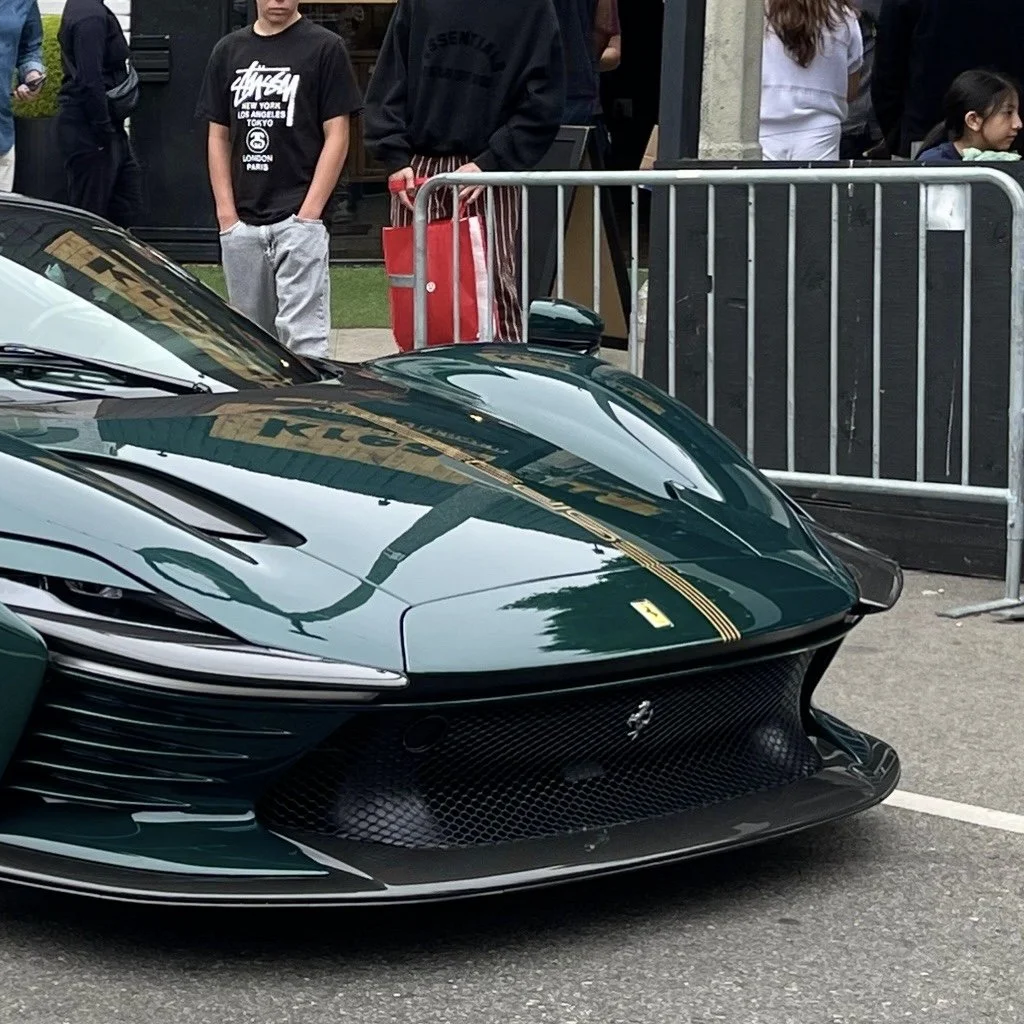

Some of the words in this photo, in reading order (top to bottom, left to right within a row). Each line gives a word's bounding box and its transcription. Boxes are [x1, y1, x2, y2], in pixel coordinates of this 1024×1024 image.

[241, 101, 258, 110] NEW
[259, 101, 281, 110] YORK
[237, 110, 250, 119] LOS
[250, 110, 286, 119] ANGELES
[246, 119, 274, 127] TOKYO
[242, 155, 273, 163] LONDON
[246, 163, 269, 171] PARIS
